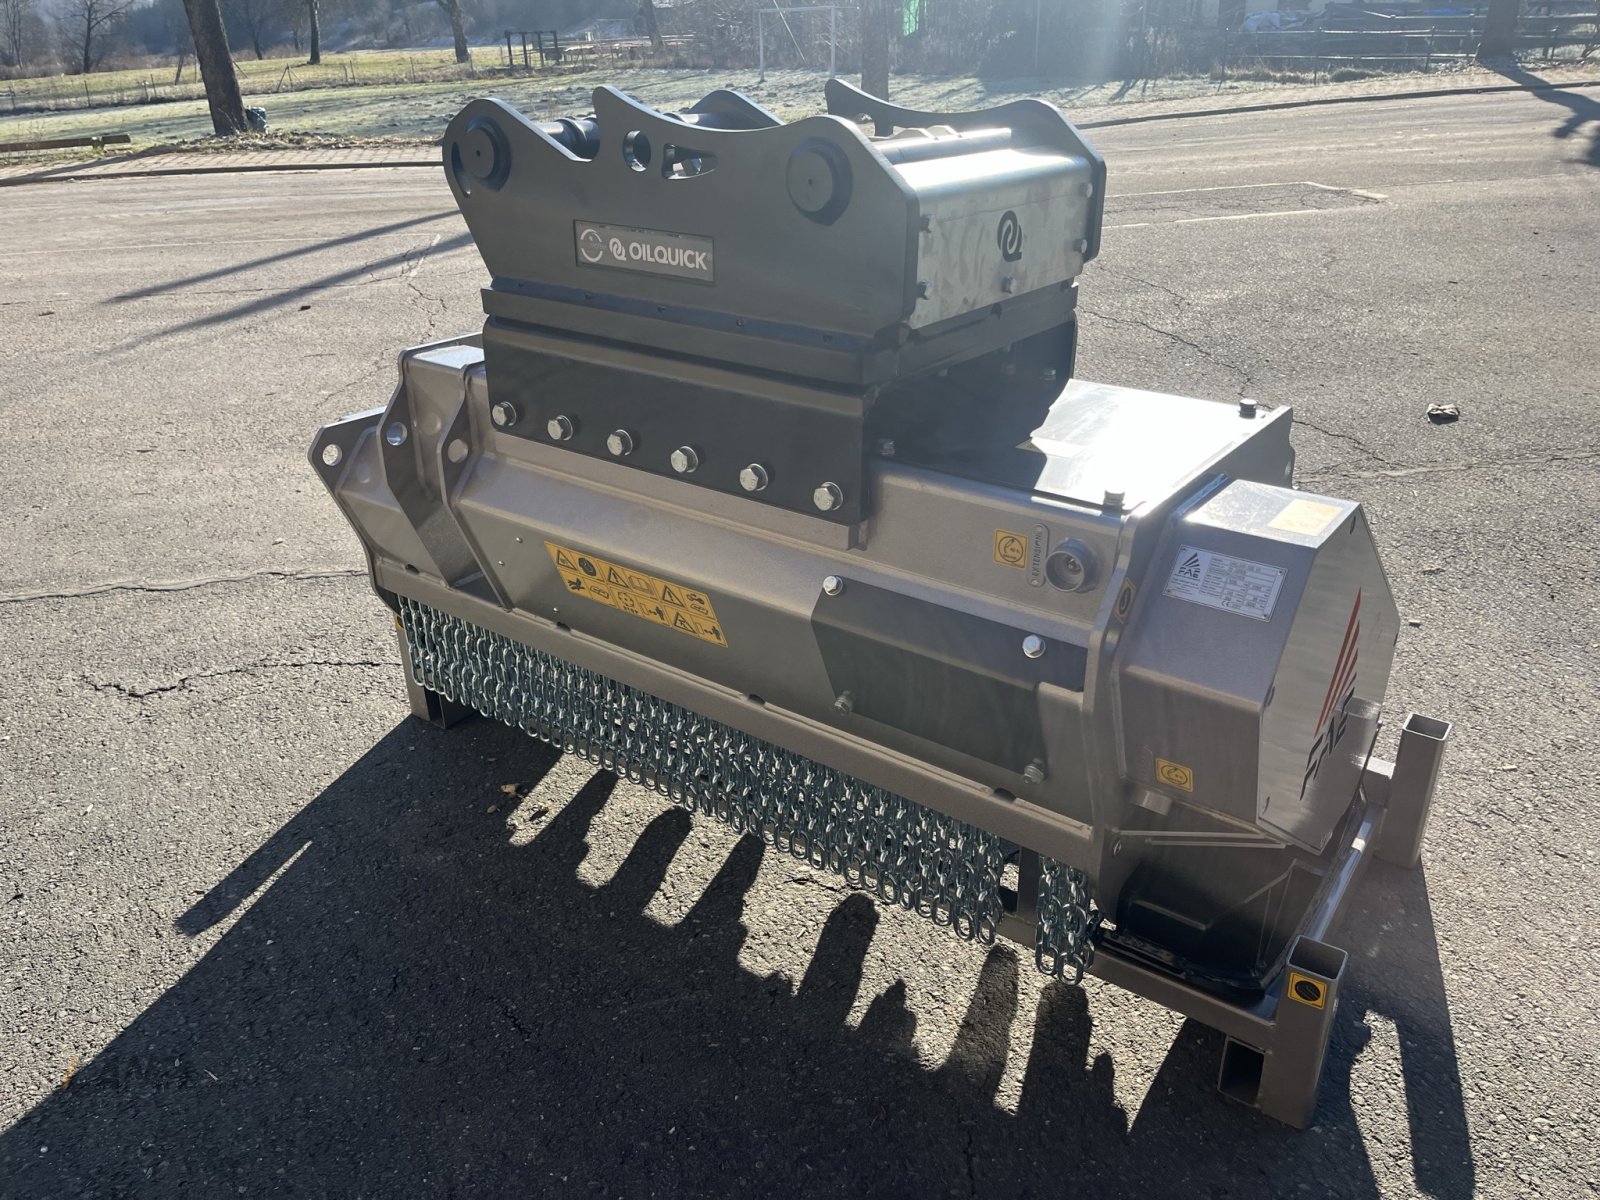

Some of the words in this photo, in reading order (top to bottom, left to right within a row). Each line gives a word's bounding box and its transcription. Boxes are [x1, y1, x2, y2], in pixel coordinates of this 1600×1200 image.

[628, 241, 708, 271] OILQUICK
[1031, 534, 1042, 577] EXTENSION
[1179, 566, 1201, 579] FAE
[1299, 686, 1356, 801] FAE
